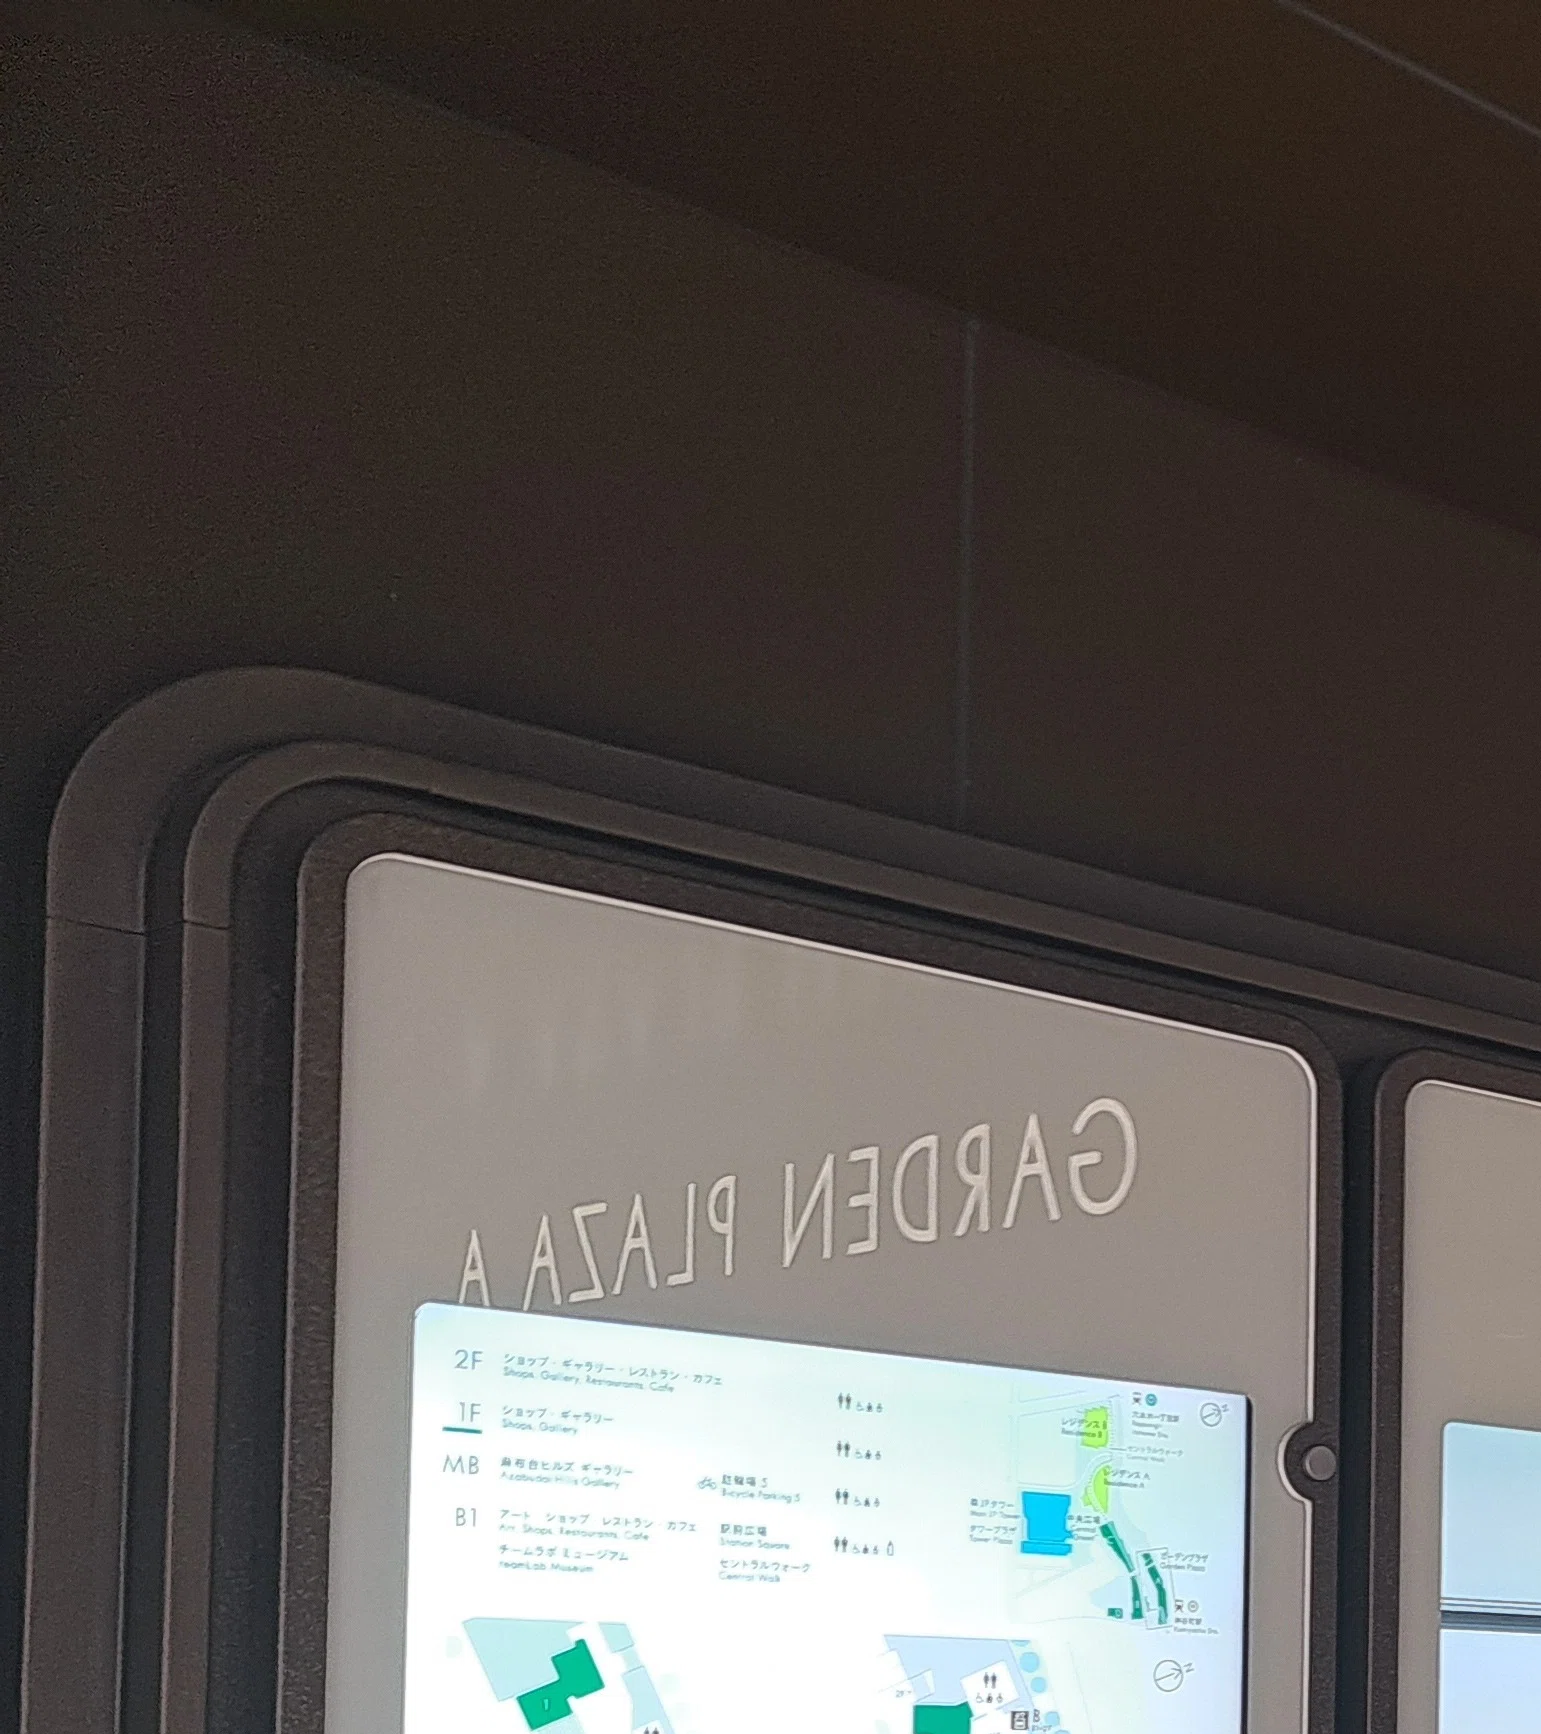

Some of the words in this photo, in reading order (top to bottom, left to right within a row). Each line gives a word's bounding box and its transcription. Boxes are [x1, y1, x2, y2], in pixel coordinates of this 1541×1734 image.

[454, 1349, 483, 1370] 2F
[459, 1402, 481, 1422] 1F
[442, 1454, 479, 1474] MB
[455, 1507, 477, 1527] B1
